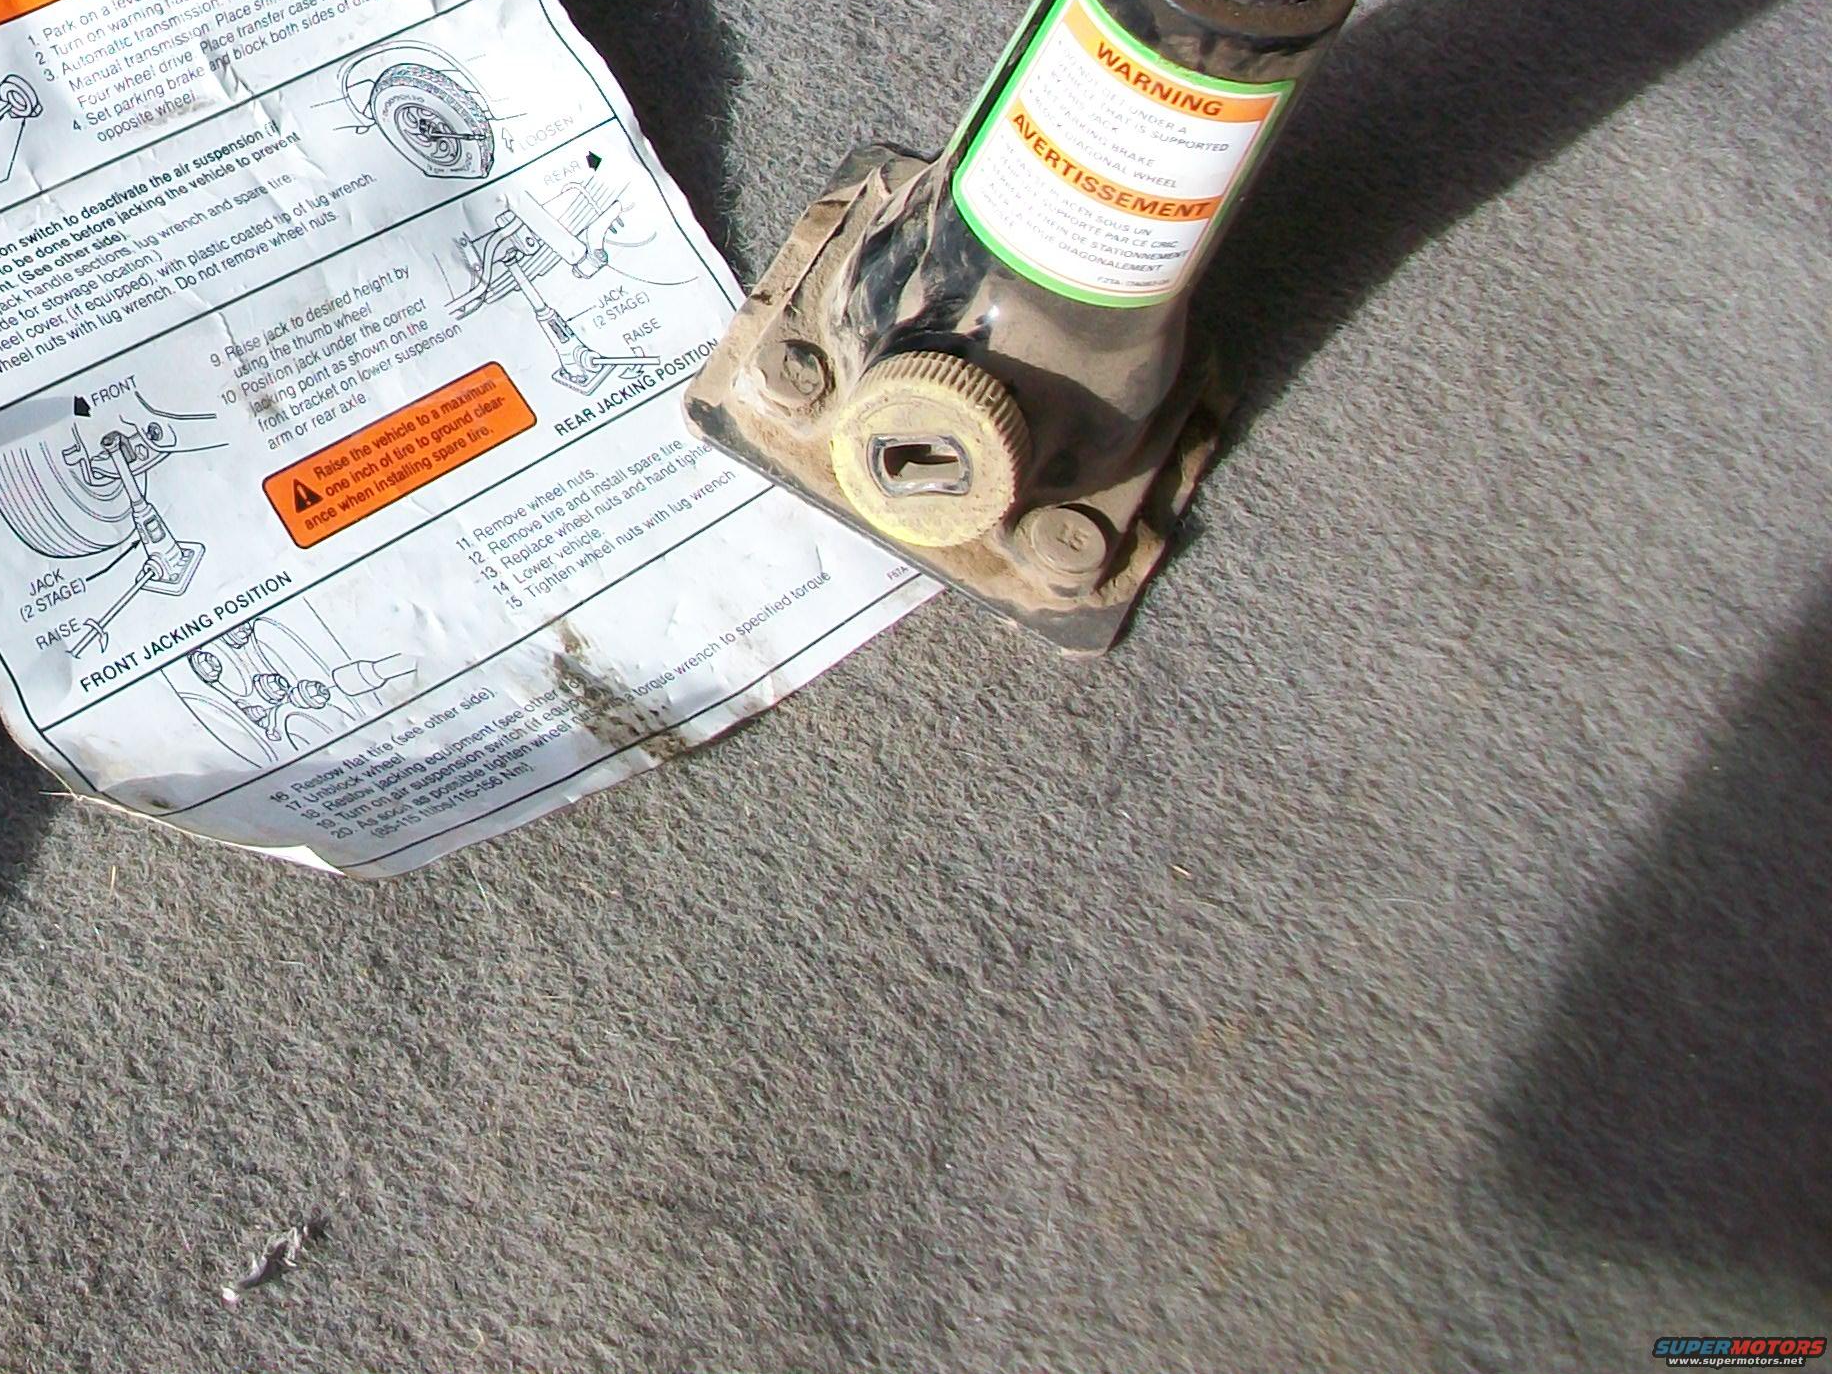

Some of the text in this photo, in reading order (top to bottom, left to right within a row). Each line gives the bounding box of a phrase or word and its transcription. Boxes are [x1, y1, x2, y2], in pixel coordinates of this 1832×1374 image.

[60, 35, 133, 76] Automatic
[1097, 40, 1224, 116] WARNING
[17, 220, 64, 248] switch
[61, 214, 79, 227] to
[79, 182, 149, 219] deactivate
[147, 171, 173, 188] the
[172, 162, 191, 178] air
[191, 129, 264, 169] suspension
[1012, 113, 1210, 217] AVERTISSEMENT
[33, 334, 67, 356] nuts
[64, 318, 98, 340] with
[94, 308, 123, 326] lug
[173, 274, 197, 291] Do
[196, 260, 222, 281] not
[219, 241, 269, 271] remove
[267, 220, 309, 247] wheel
[64, 301, 84, 321] (if
[155, 257, 187, 277] with
[185, 239, 230, 267] plastic
[229, 217, 274, 245] coated
[271, 211, 294, 226] tip
[291, 201, 308, 217] of
[304, 194, 330, 210] lug
[596, 284, 629, 309] JACK
[222, 335, 261, 363] Raise
[262, 320, 291, 350] jack
[289, 315, 304, 330] to
[304, 289, 352, 326] desired
[351, 271, 394, 300] height
[391, 264, 409, 281] by
[232, 300, 373, 380] using the thumb wheel
[239, 360, 294, 398] Position
[291, 348, 322, 375] jack
[320, 330, 358, 358] under
[358, 319, 382, 338] the
[381, 296, 427, 330] correct
[604, 290, 650, 321] STAGE)
[621, 316, 662, 345] RAISE
[89, 373, 137, 407] FRONT
[552, 337, 718, 436] REAR JACKING POSITION
[303, 506, 338, 530] ance
[336, 486, 375, 512] when
[372, 456, 433, 493] installing
[431, 437, 467, 462] spare
[312, 455, 350, 481] Raise
[348, 443, 373, 462] the
[370, 420, 416, 450] vehicle
[414, 413, 430, 427] to
[429, 408, 441, 420] a
[324, 477, 351, 497] one
[348, 461, 380, 484] inch
[378, 451, 394, 468] of
[391, 442, 416, 460] tire
[413, 435, 430, 449] to
[429, 409, 474, 444] ground
[471, 506, 527, 542] Remove
[525, 481, 568, 511] wheel
[523, 564, 577, 598] Tighten
[574, 538, 616, 568] wheel
[614, 524, 644, 546] nuts
[640, 509, 671, 529] with
[666, 497, 693, 514] lug
[19, 576, 86, 623] (2 STAGE)
[28, 567, 66, 597] JACK
[672, 564, 831, 675] wrench to specified torque
[34, 616, 82, 650] RAISE
[79, 570, 292, 693] FRONT JACKING POSITION
